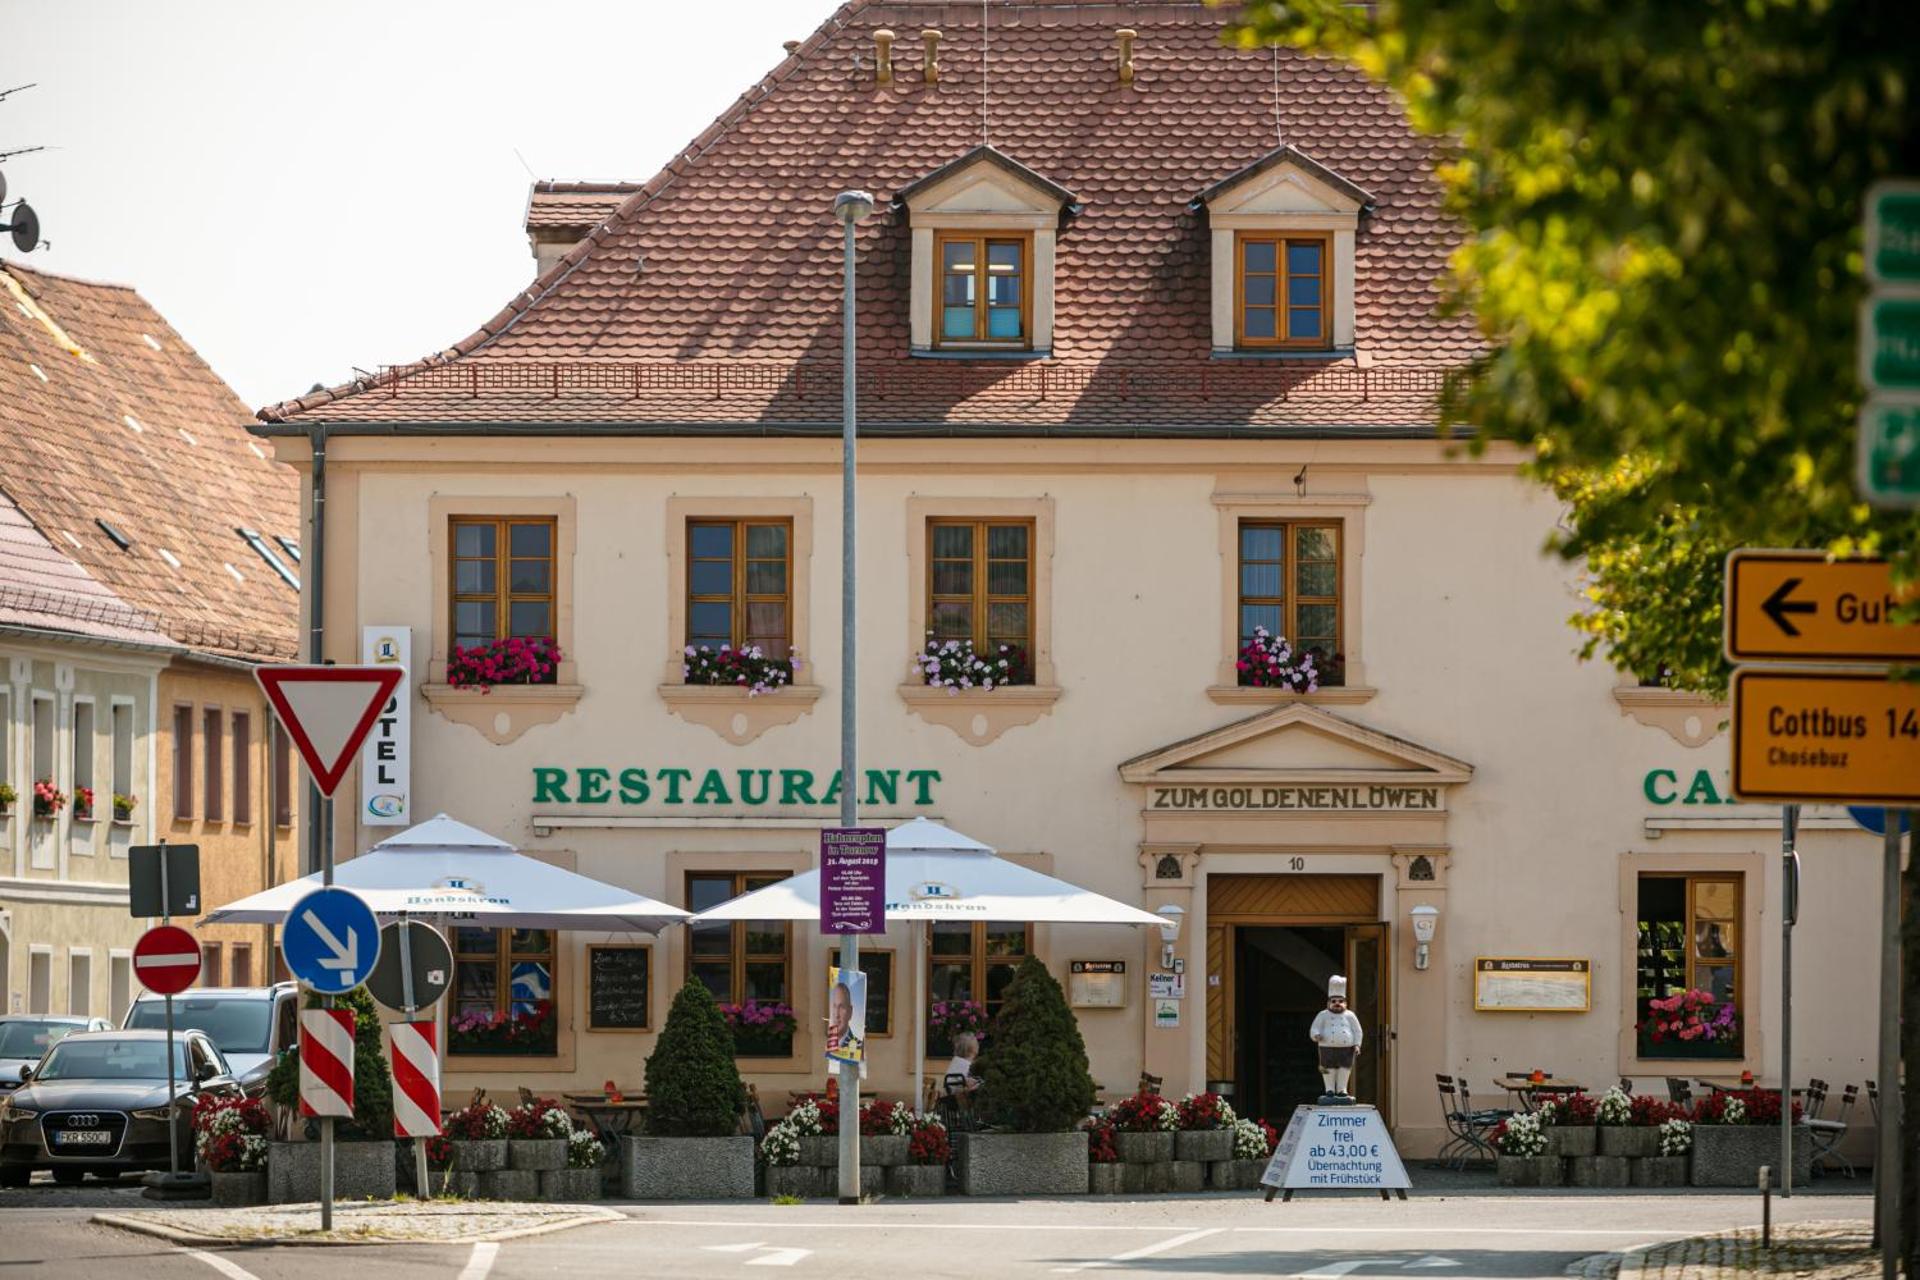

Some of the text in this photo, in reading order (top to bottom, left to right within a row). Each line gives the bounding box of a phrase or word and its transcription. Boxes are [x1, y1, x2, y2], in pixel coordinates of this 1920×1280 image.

[1836, 592, 1920, 625] Gub
[1768, 705, 1918, 739] Cottbus 14
[1643, 768, 1737, 805] CA
[1154, 785, 1439, 809] ZUM GOLDENEN LÖWEN
[1288, 856, 1305, 871] 10
[1318, 1114, 1367, 1128] Zimmer
[1333, 1130, 1355, 1143] frei
[1309, 1144, 1379, 1159] ab 43,00 €
[1307, 1158, 1383, 1174] Übernachtung
[1310, 1173, 1381, 1185] mit Frühstück
